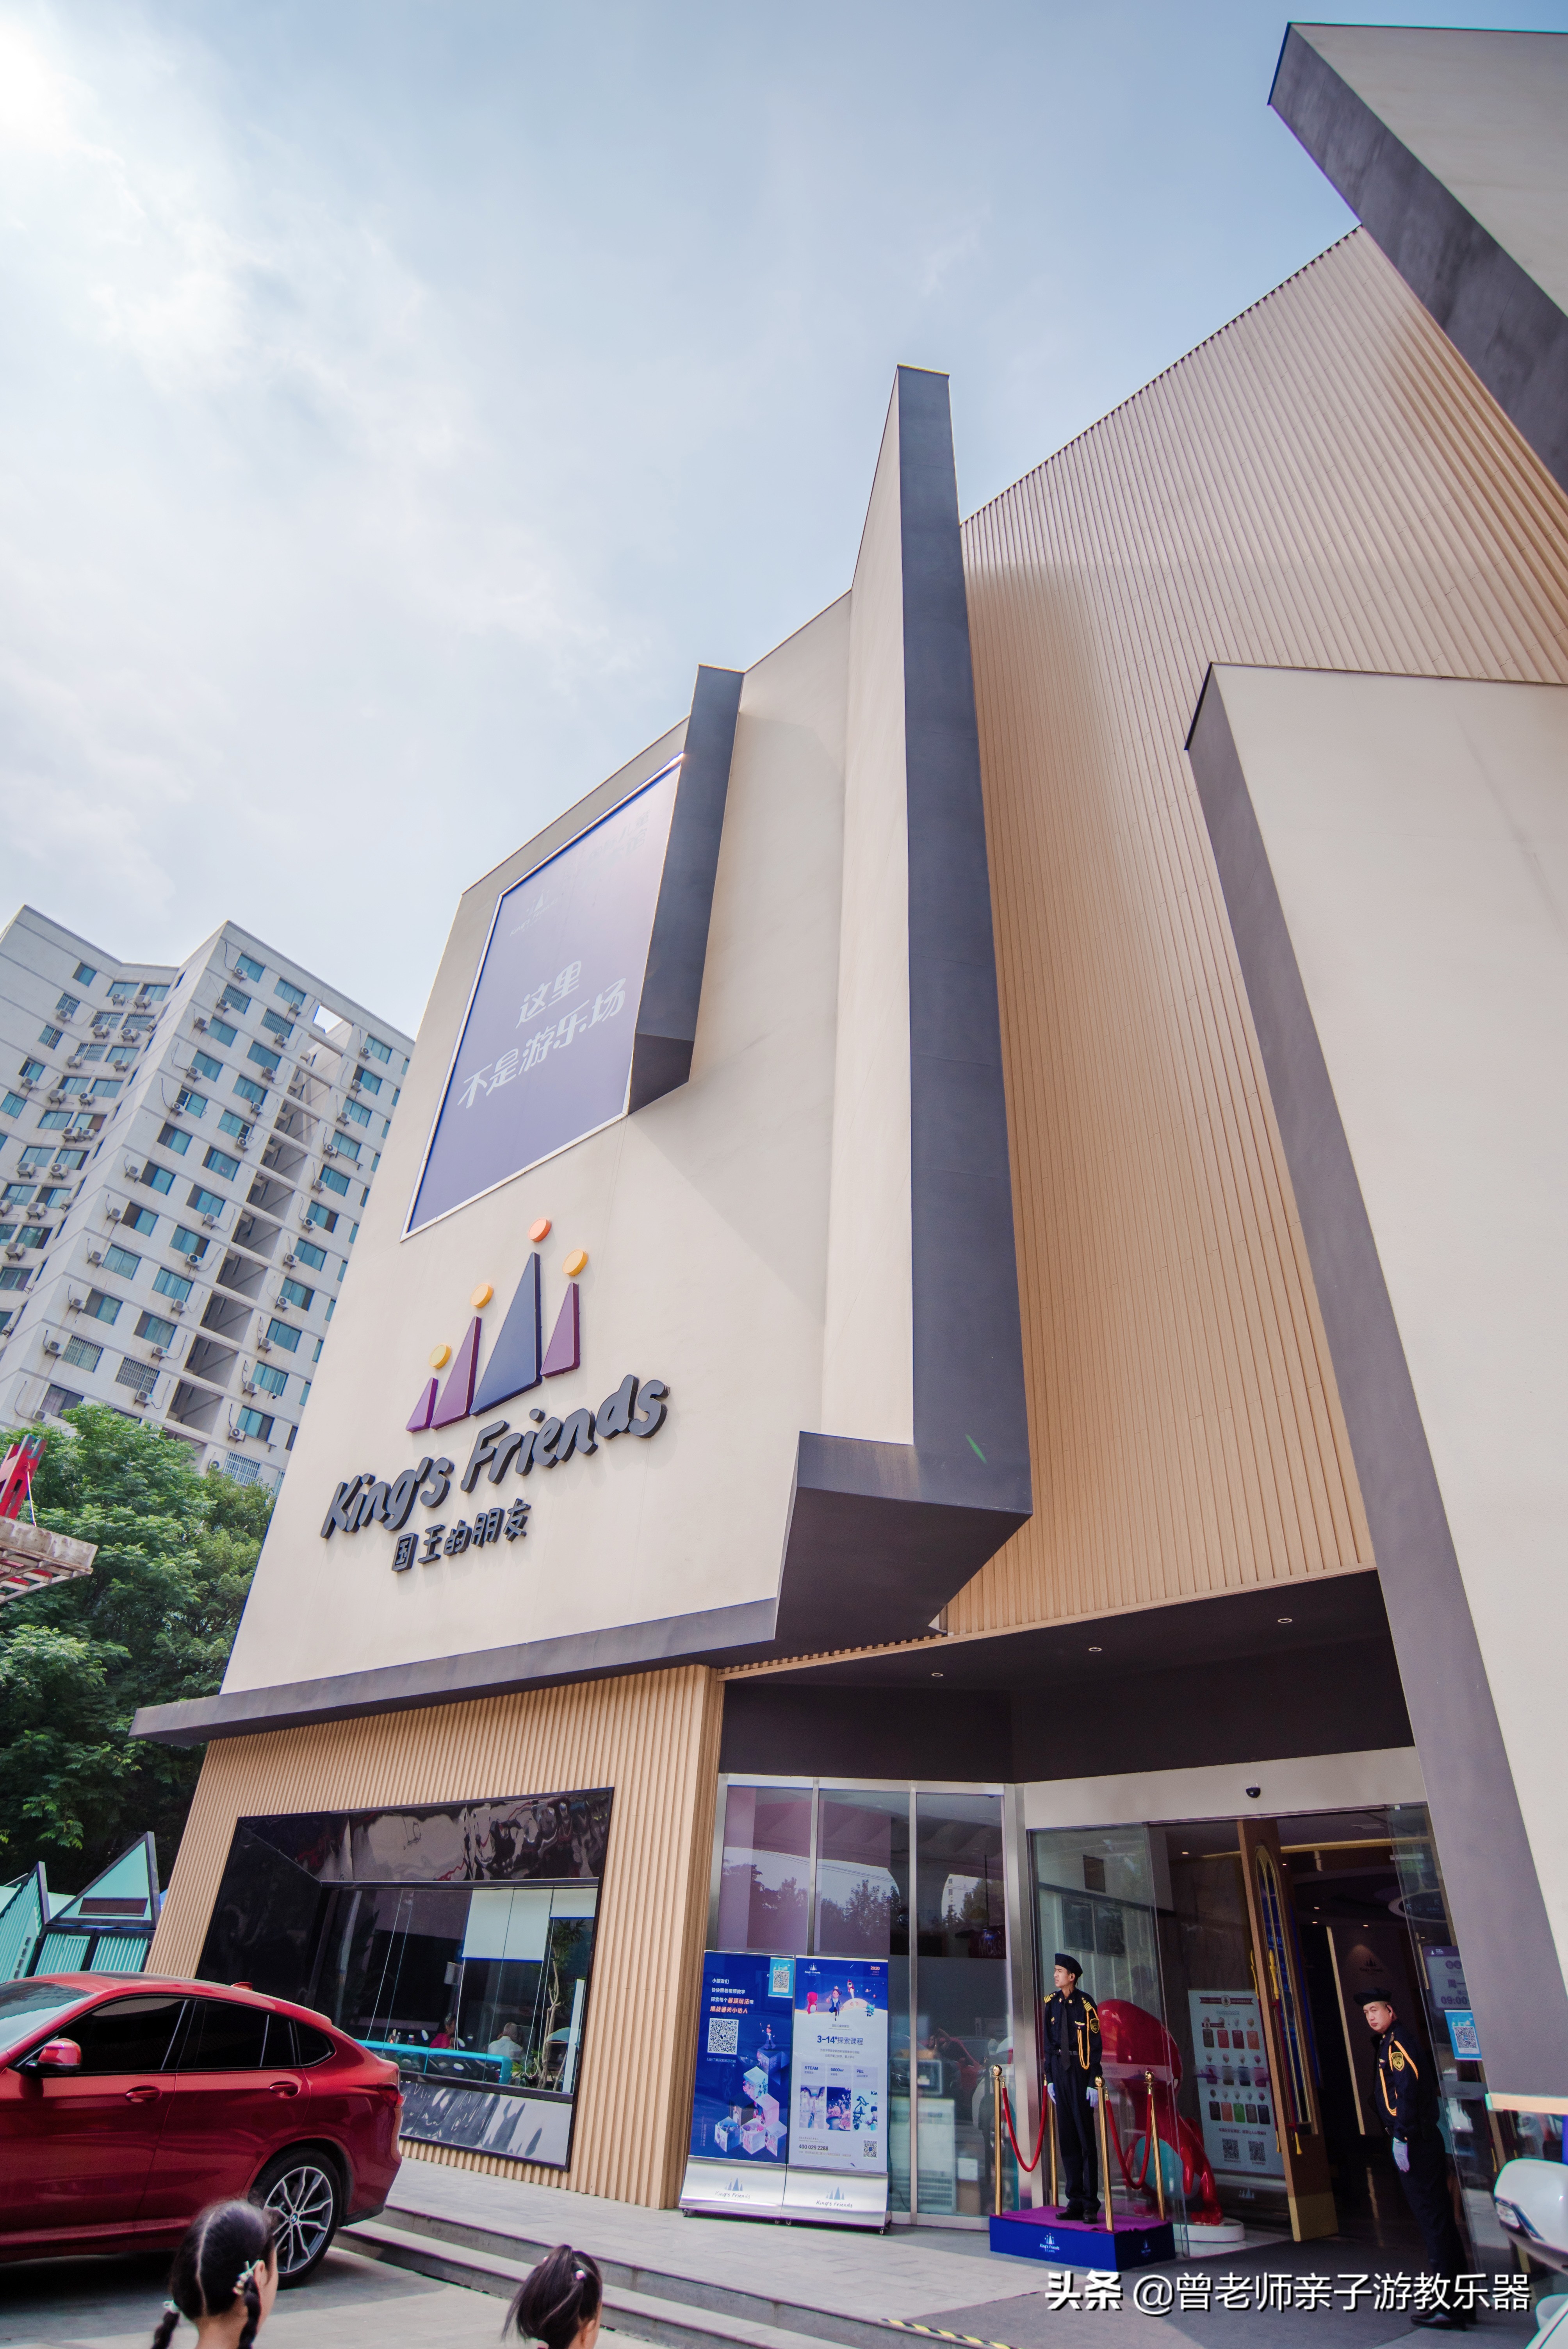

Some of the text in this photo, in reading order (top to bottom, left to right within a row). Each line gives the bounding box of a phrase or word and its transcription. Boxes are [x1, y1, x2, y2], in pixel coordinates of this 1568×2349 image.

[514, 960, 582, 1029] 这里
[457, 978, 627, 1109] 不是游乐场
[320, 1374, 671, 1539] King's Friends
[391, 1498, 531, 1573] 国王的朋友
[710, 2006, 748, 2014] 挑战通关小达人
